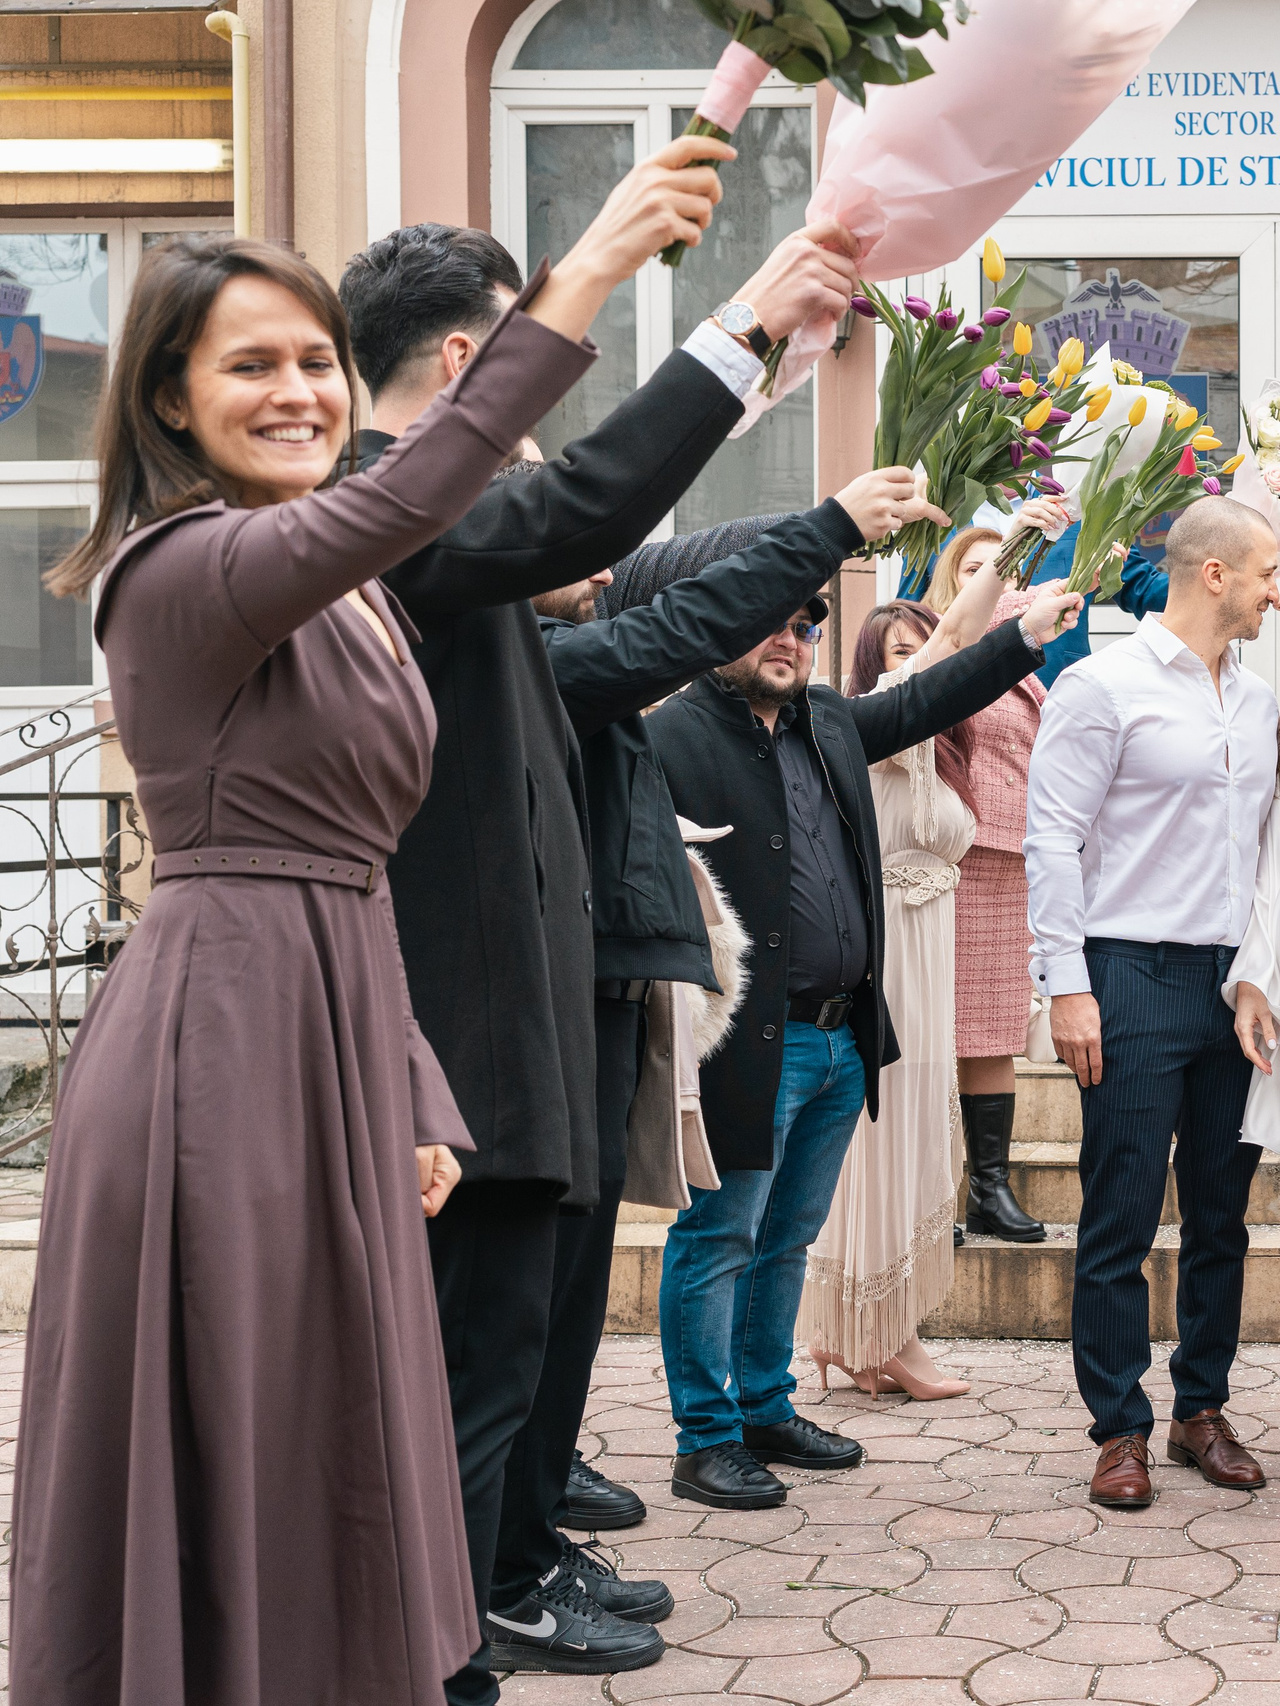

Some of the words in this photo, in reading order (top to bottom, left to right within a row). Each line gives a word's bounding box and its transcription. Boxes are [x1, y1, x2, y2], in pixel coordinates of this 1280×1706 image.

[1124, 73, 1141, 97] E
[1174, 110, 1276, 136] SECTOR
[1034, 156, 1166, 188] VICIUL
[1177, 156, 1229, 187] DE
